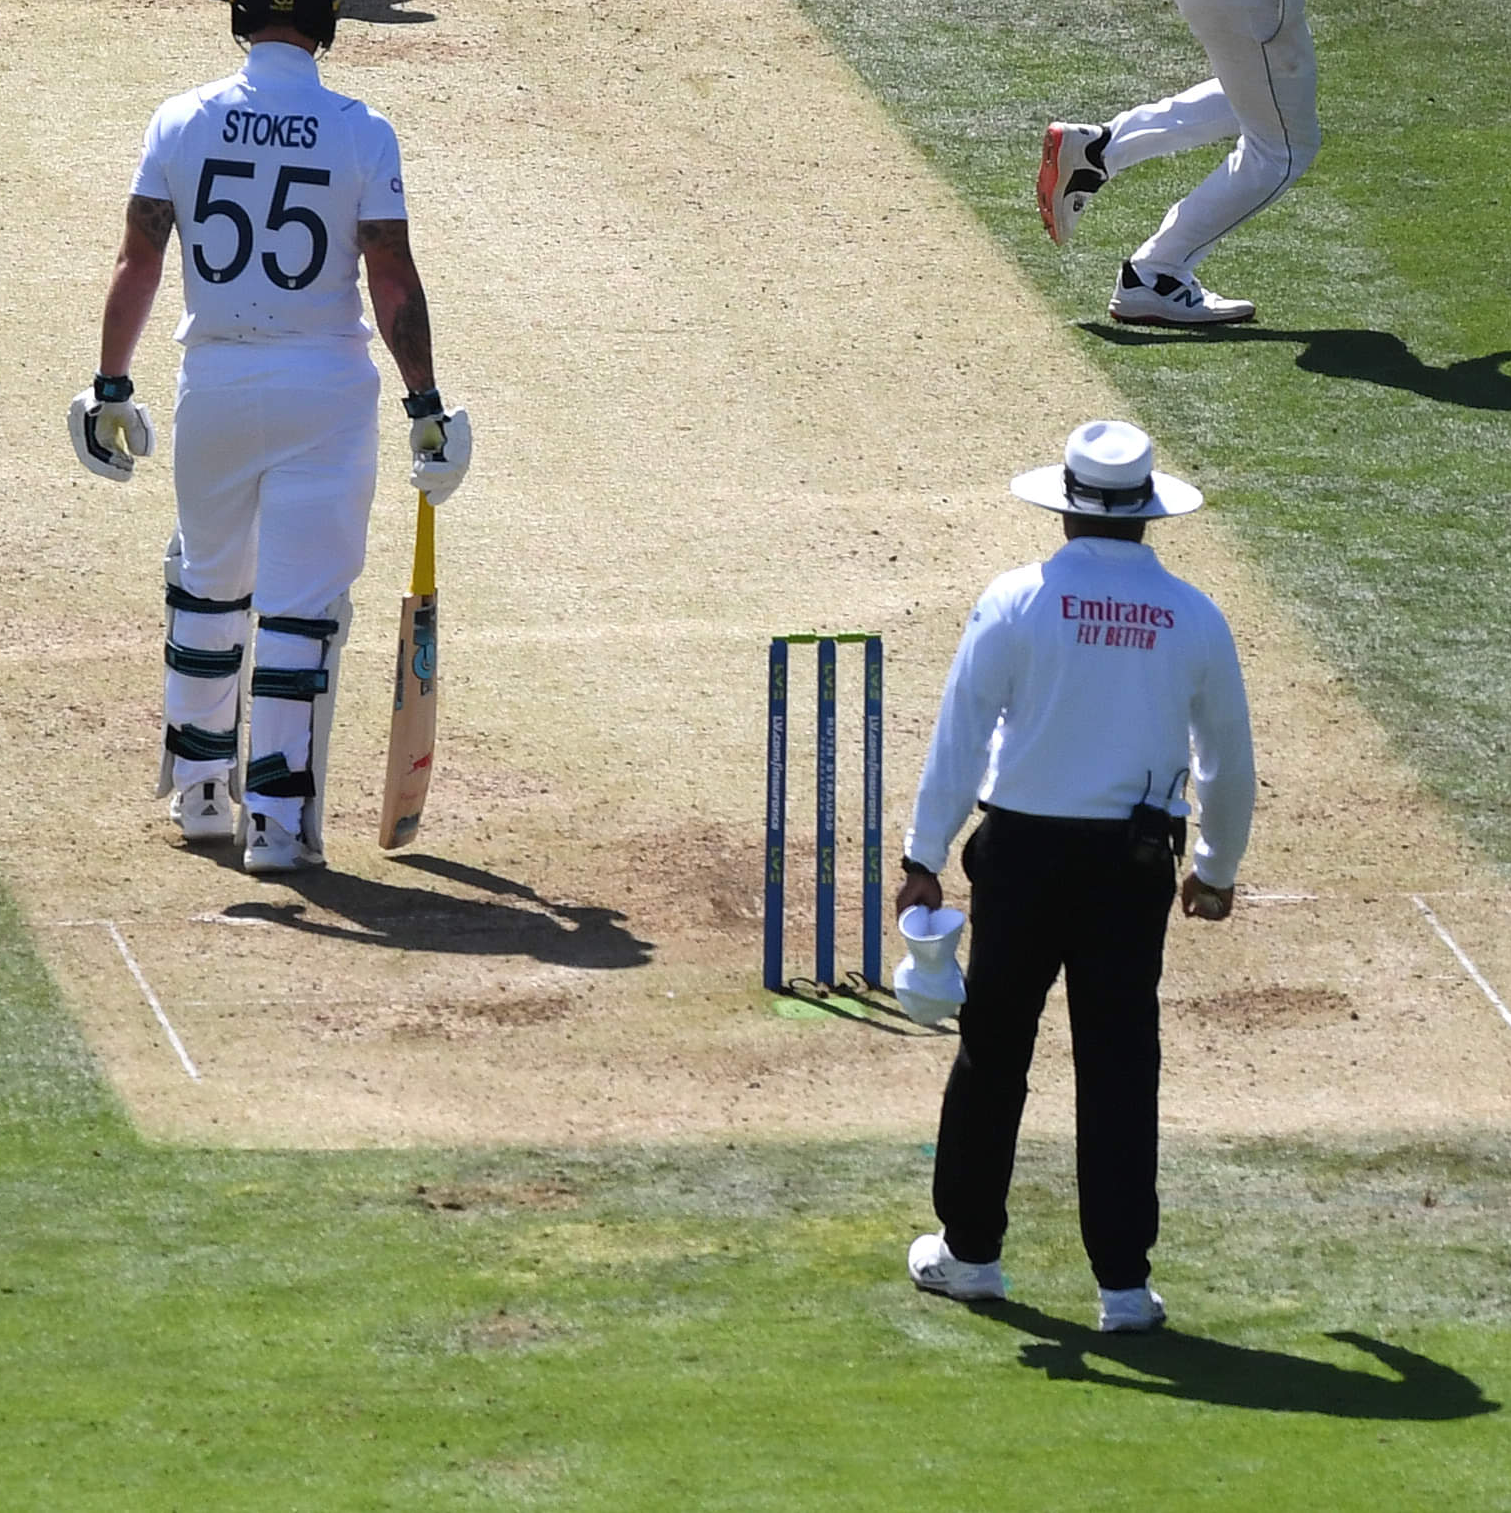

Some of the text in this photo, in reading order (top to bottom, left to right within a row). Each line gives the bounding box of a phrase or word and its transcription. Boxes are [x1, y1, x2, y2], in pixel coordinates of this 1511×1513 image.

[222, 109, 319, 149] STOKES
[192, 158, 331, 291] 55
[1061, 594, 1175, 629] Emirates
[1076, 624, 1156, 650] FLY BETTER
